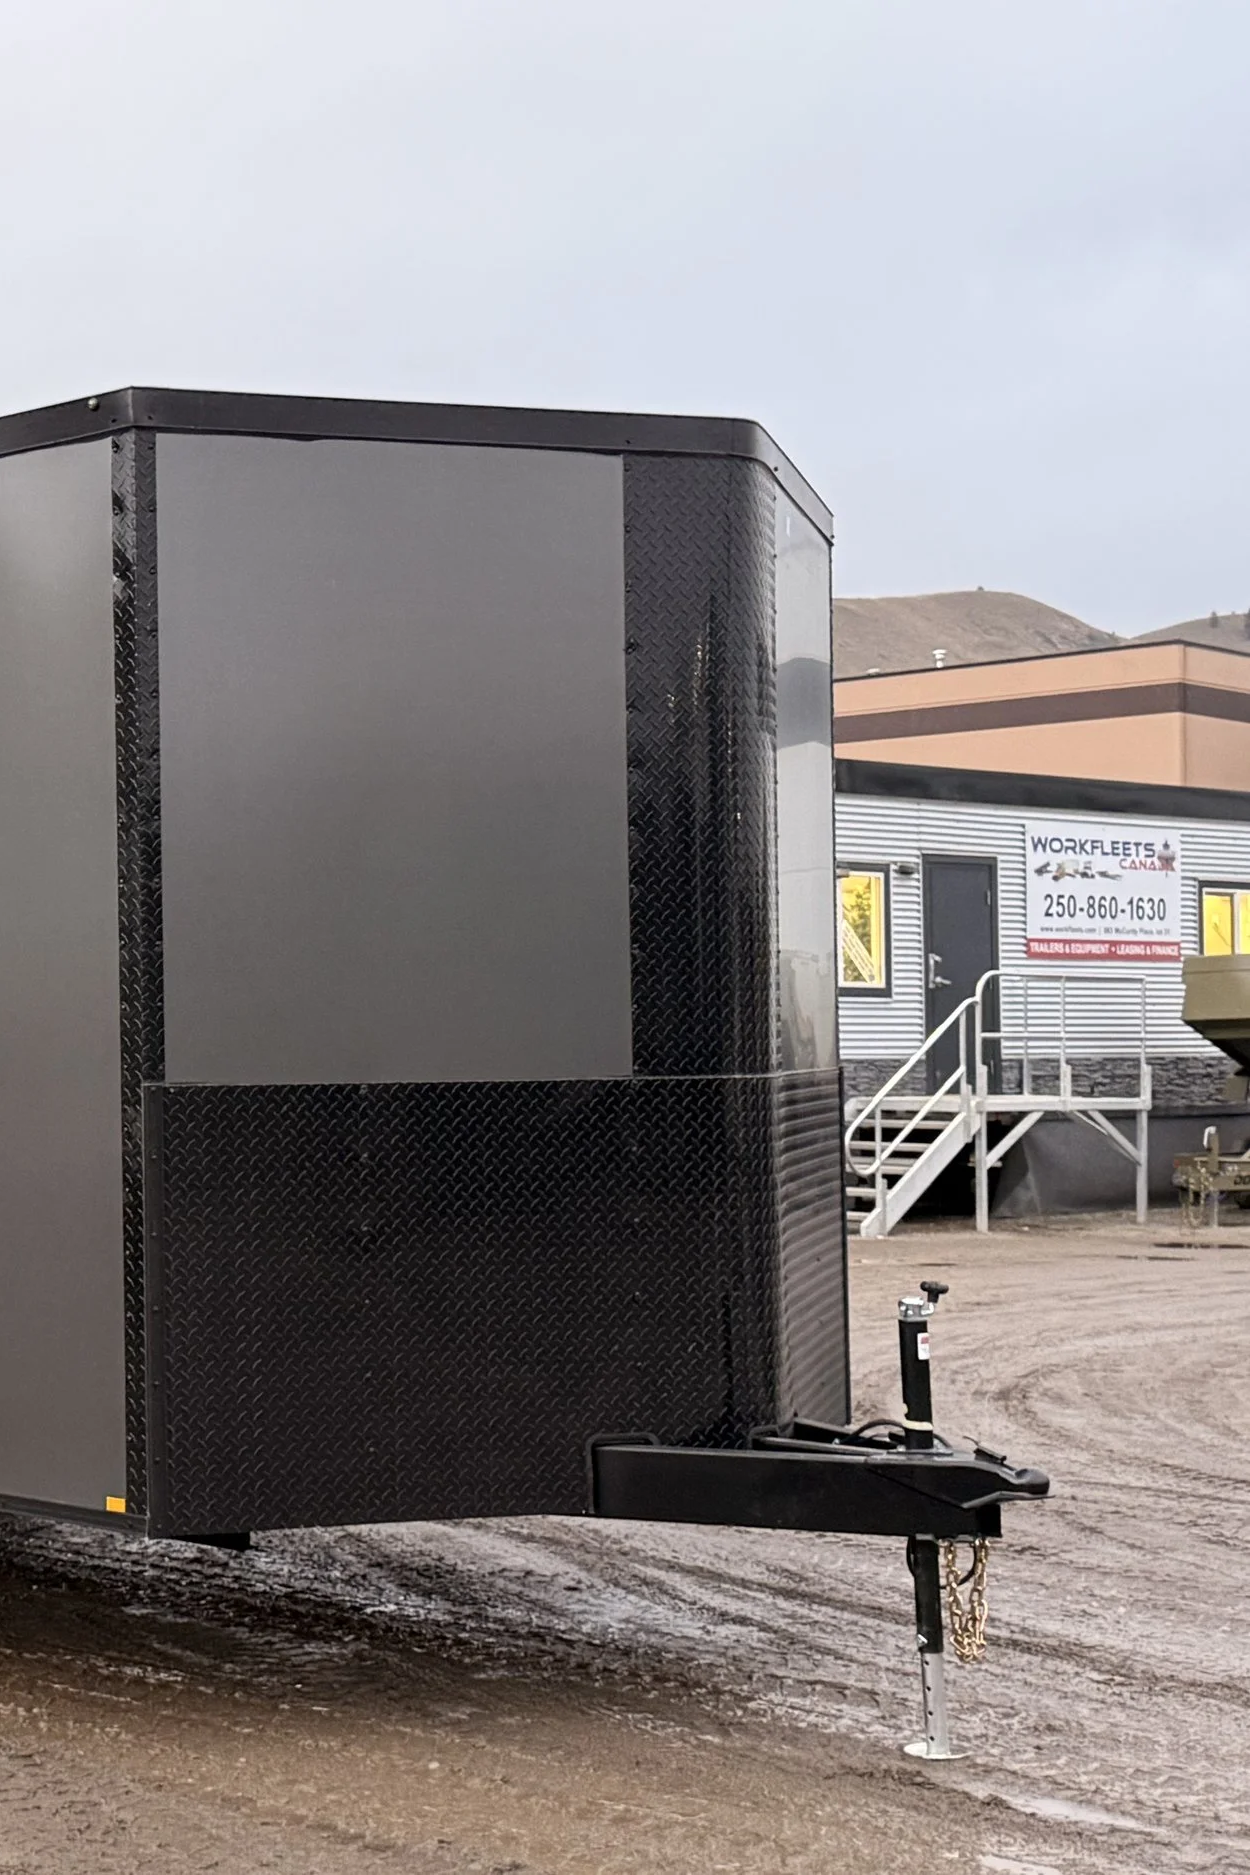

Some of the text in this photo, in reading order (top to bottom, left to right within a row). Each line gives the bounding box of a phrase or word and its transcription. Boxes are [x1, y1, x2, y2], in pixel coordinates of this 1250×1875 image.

[1031, 836, 1156, 858] WORKFLEETS
[1044, 894, 1167, 921] 250-860-1630
[1030, 942, 1064, 953] TRAILERS
[1071, 943, 1109, 954] EQUIPMENT
[1116, 944, 1146, 955] LEASING
[1151, 945, 1179, 956] FINANCE
